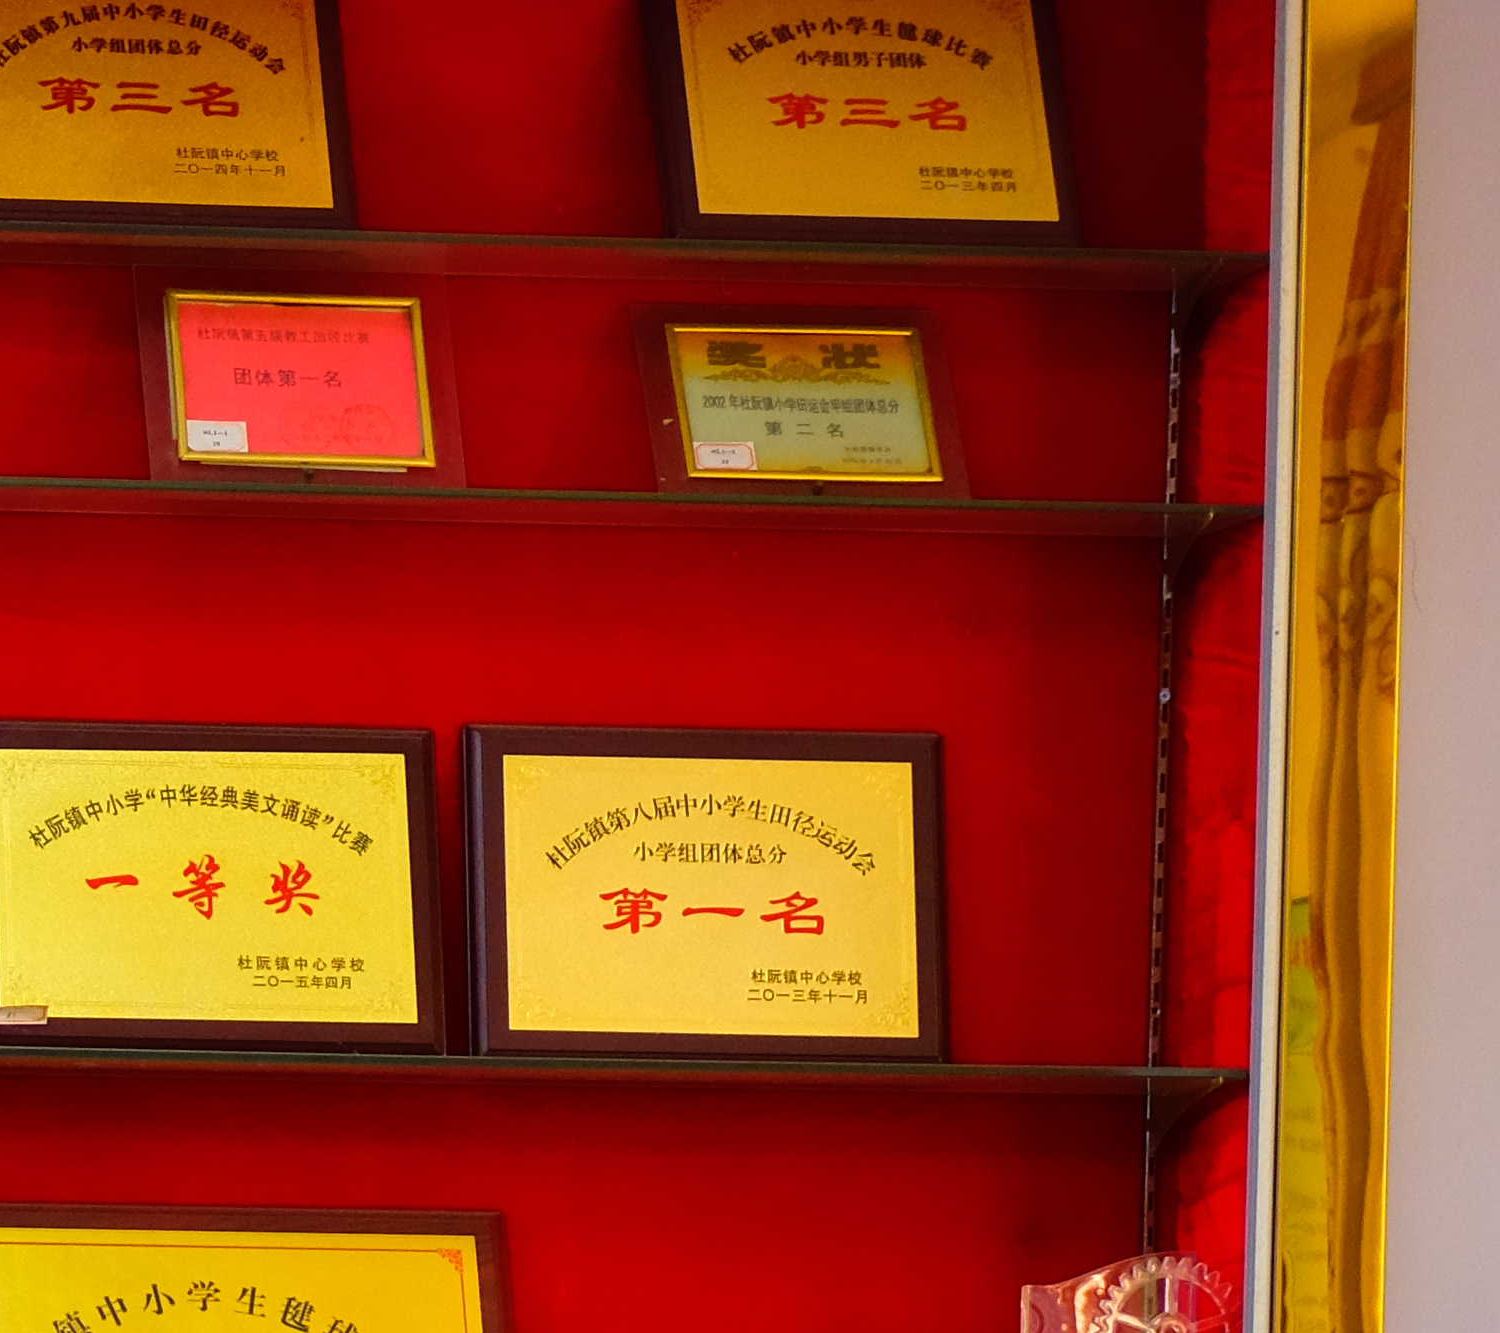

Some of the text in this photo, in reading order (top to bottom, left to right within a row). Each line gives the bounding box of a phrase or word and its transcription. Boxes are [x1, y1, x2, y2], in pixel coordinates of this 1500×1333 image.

[72, 36, 202, 56] 小学组团体总分
[796, 50, 927, 70] 小学组男子团体
[37, 76, 240, 118] 第三名
[767, 91, 968, 132] 第三名
[176, 145, 279, 162] 杜阮镇中心学校
[918, 166, 1014, 180] 杜阮镇中心学校
[707, 340, 881, 370] 奖状
[233, 367, 342, 389] 团体第一名
[764, 420, 845, 438] 第二名
[545, 793, 876, 876] 杜阮镇第八届中小学生田径运动会
[633, 841, 787, 865] 小学组团体总分
[85, 854, 320, 920] 一等奖
[599, 887, 824, 935] 第一名
[238, 956, 365, 972] 杜阮镇中心学校
[751, 969, 862, 986] 杜阮镇中心学校
